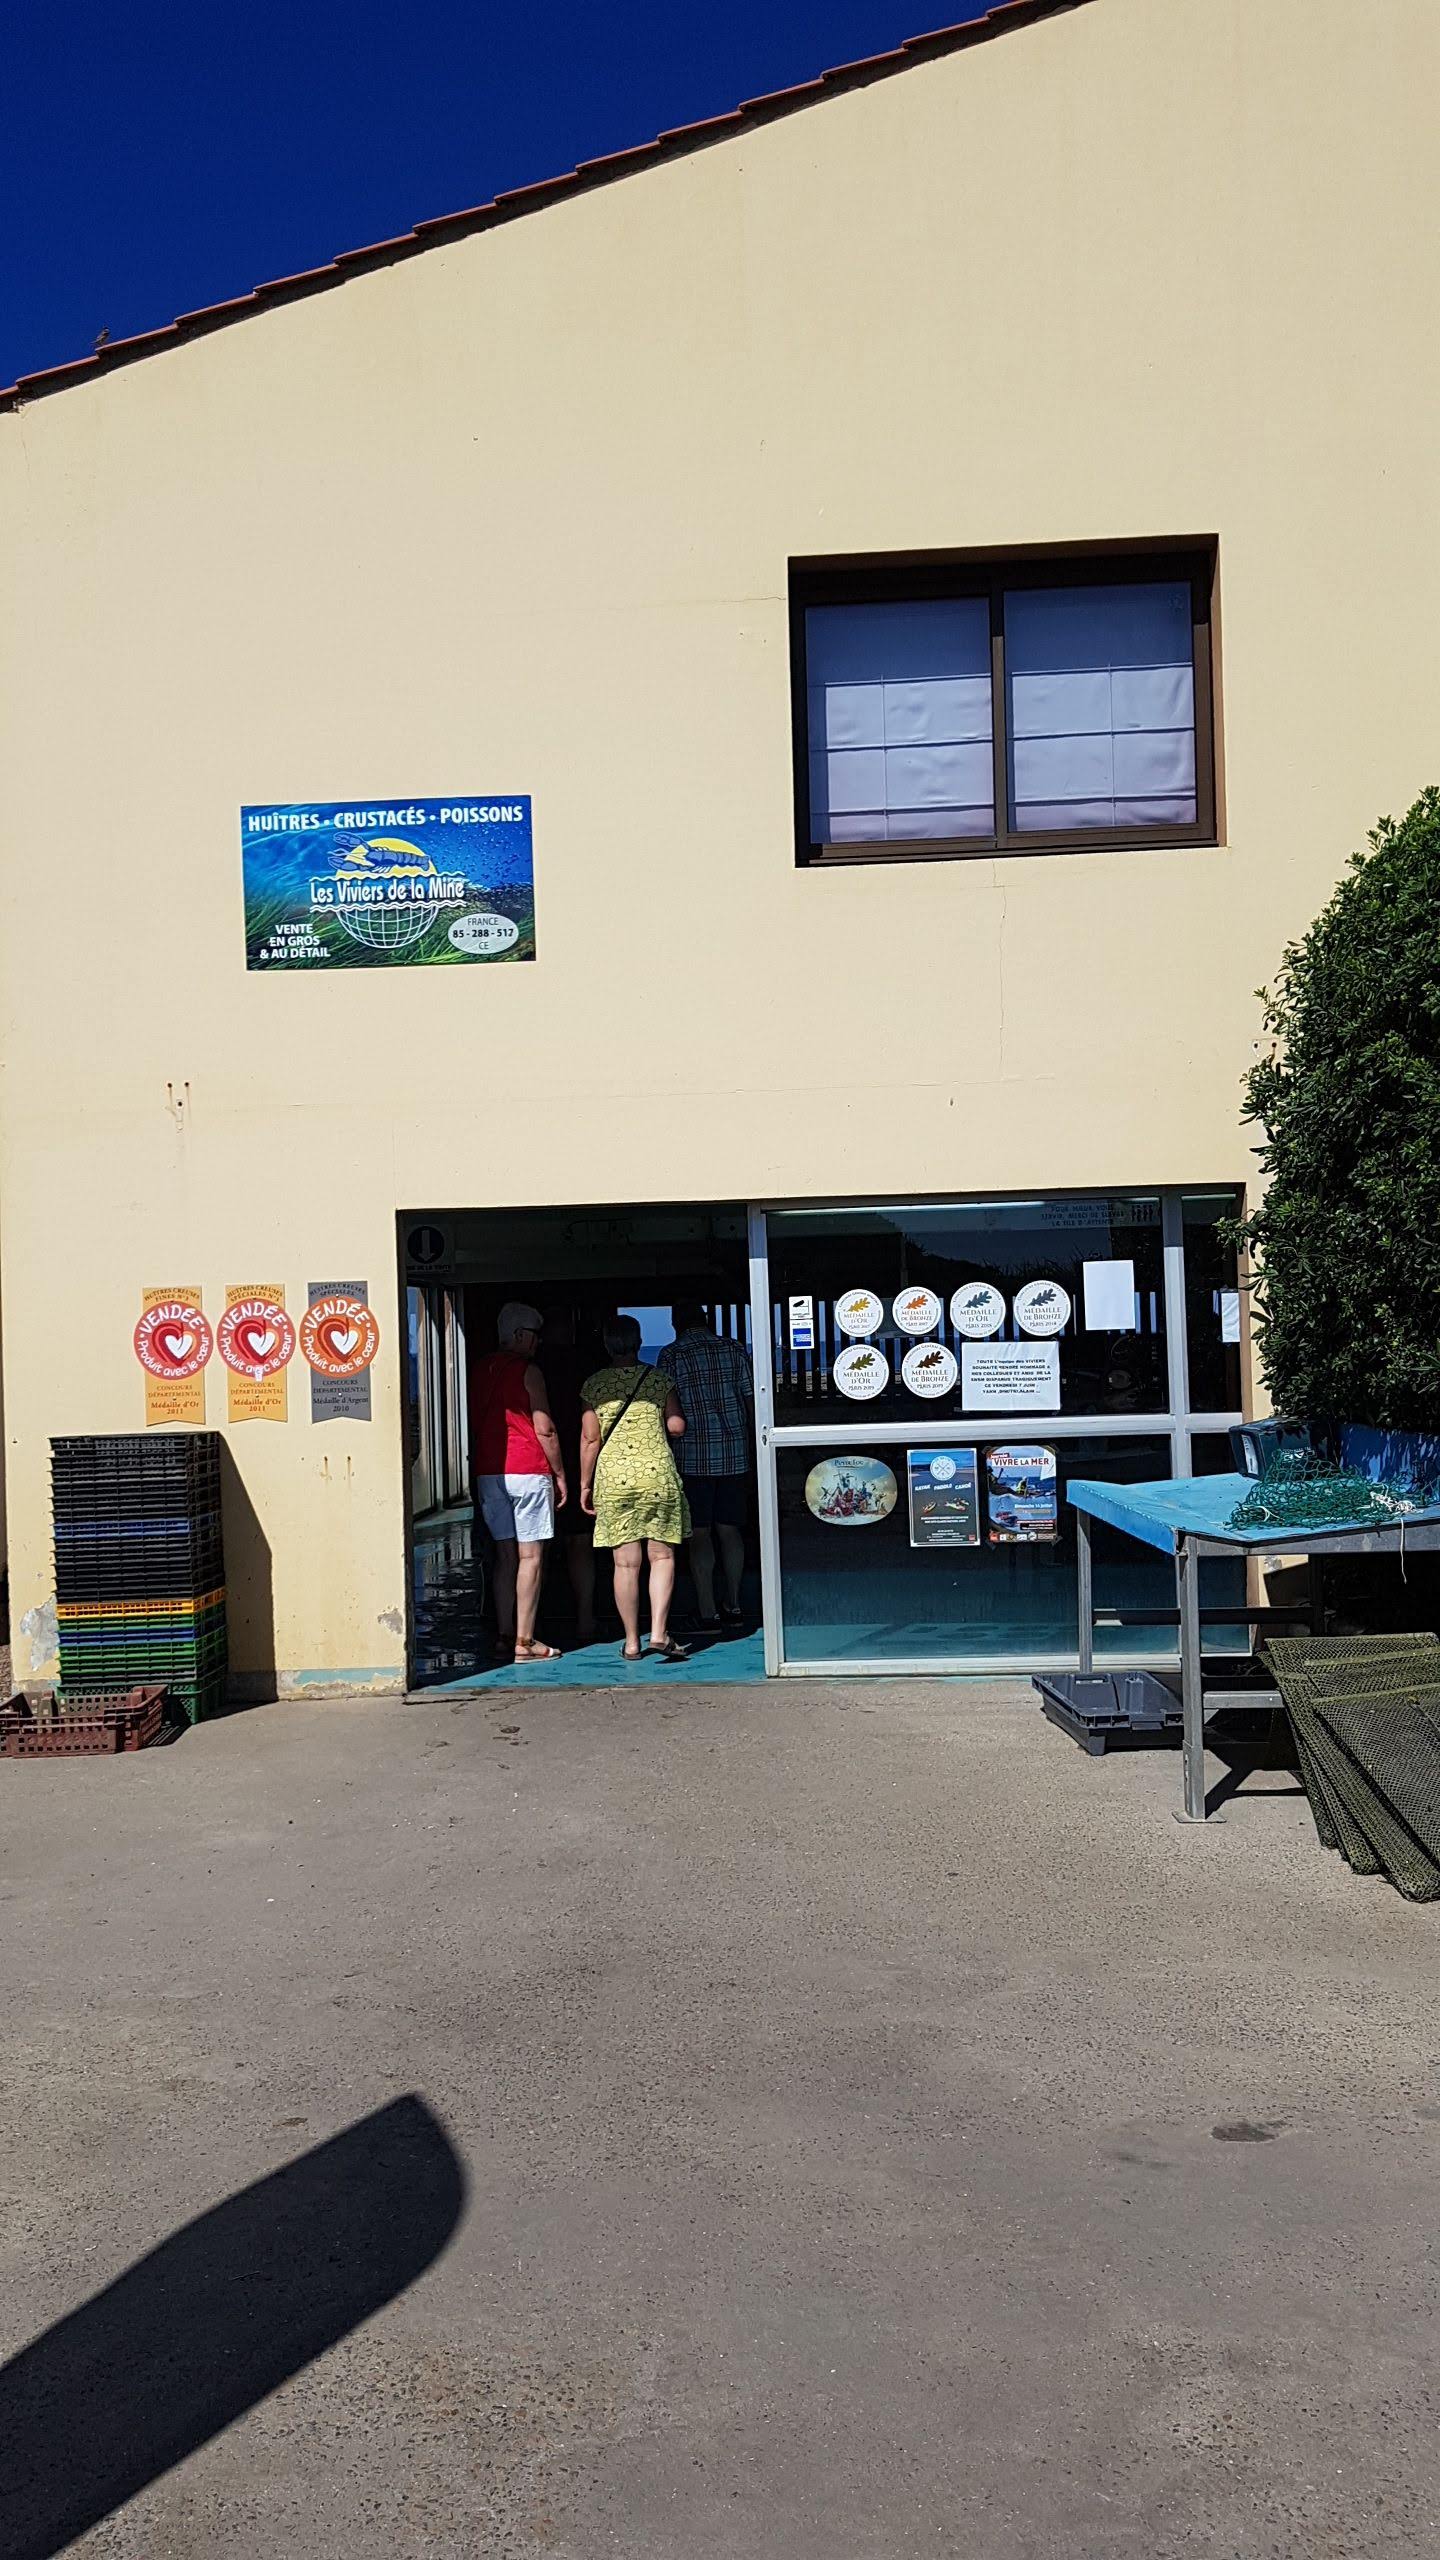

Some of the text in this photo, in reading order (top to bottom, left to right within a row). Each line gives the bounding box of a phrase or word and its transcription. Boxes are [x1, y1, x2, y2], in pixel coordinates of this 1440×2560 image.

[248, 806, 523, 831] HUÎTRES CRUSTACÉS POISSONS
[310, 876, 465, 903] Les Viviers de la Mine
[275, 924, 313, 935] VENTE
[467, 917, 499, 927] FRANCE
[259, 944, 331, 959] & AU DÉTAIL
[269, 935, 320, 947] EN GROS
[478, 941, 489, 950] CE
[139, 1304, 204, 1333] VENDÉE
[222, 1302, 287, 1330] VENDÉE
[304, 1299, 370, 1329] VENDÉE
[138, 1340, 163, 1373] Produit
[163, 1367, 189, 1376] avec
[188, 1361, 198, 1371] le
[220, 1337, 245, 1370] Produit
[270, 1358, 280, 1368] le
[303, 1335, 328, 1369] Produit
[329, 1362, 354, 1372] avec
[353, 1356, 364, 1367] le
[994, 1458, 1019, 1466] VIVRE
[1031, 1457, 1049, 1465] MER
